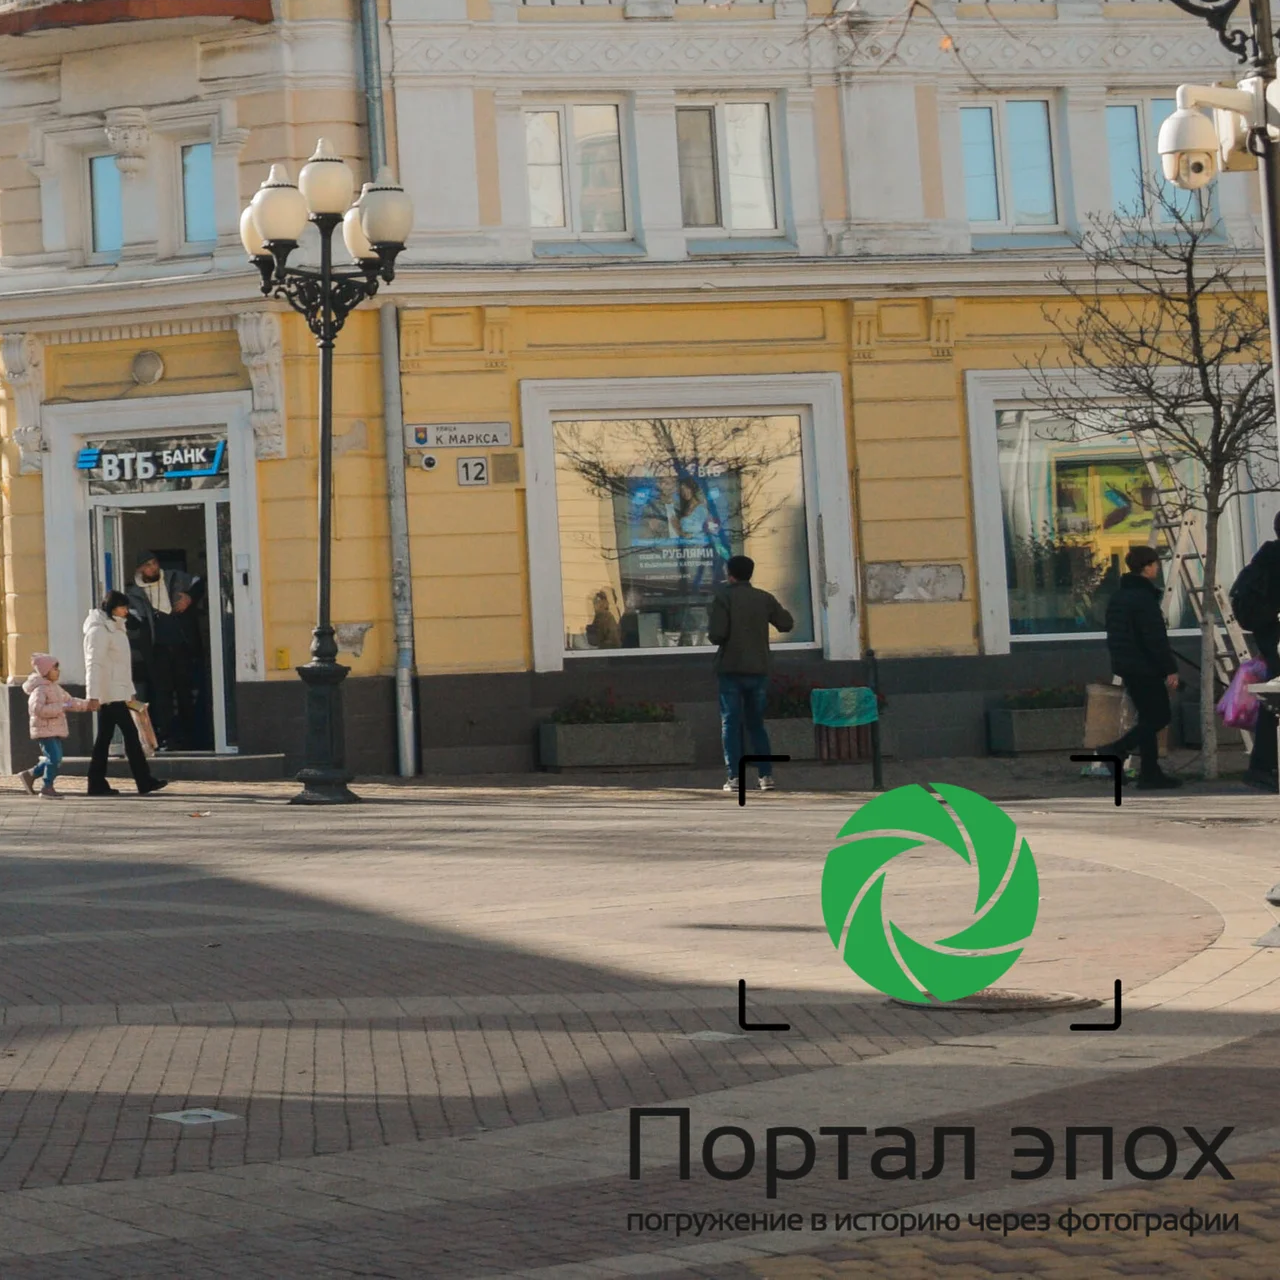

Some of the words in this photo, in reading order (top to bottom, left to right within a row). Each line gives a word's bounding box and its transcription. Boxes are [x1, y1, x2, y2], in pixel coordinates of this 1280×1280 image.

[449, 434, 499, 444] МАРКСА
[102, 452, 156, 481] ВТБ
[162, 448, 207, 465] БАНК
[462, 463, 485, 481] 12
[662, 548, 714, 559] РУБЛЯМИ
